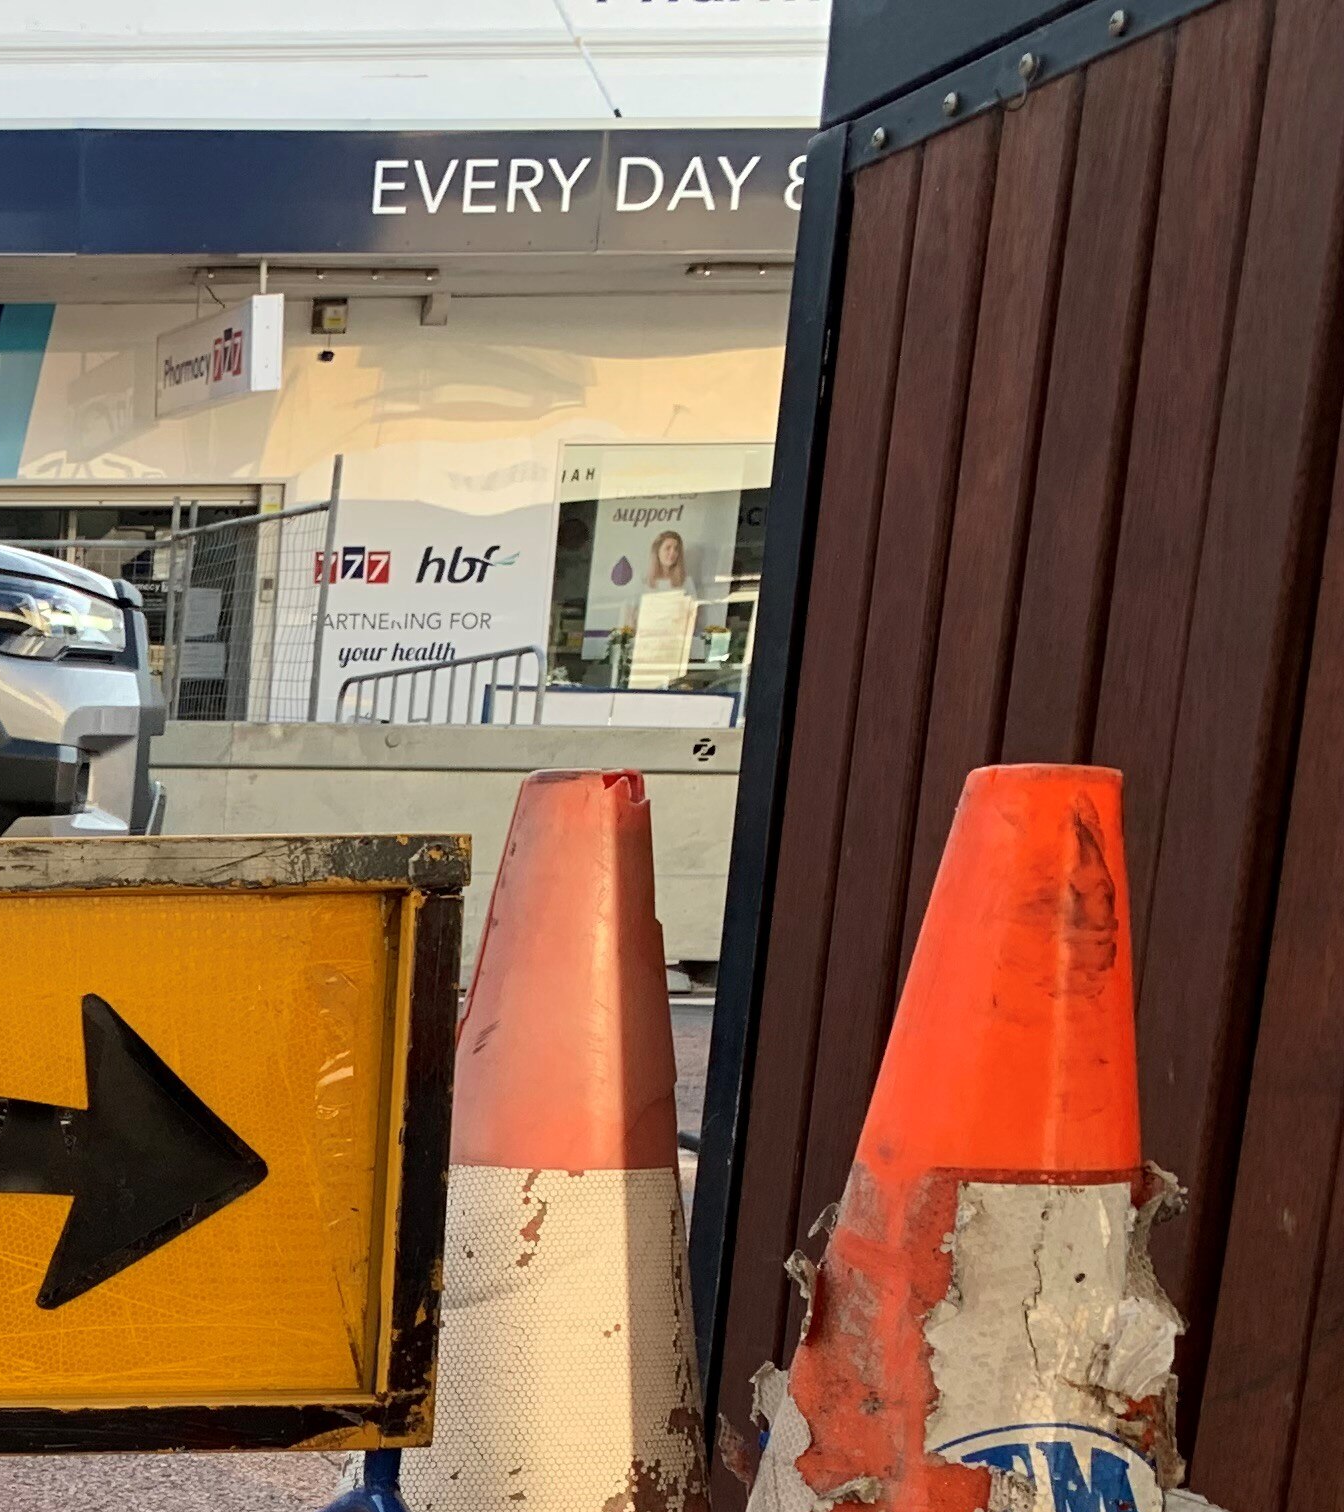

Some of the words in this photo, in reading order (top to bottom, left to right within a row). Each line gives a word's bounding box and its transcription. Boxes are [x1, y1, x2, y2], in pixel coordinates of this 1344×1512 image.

[372, 157, 592, 214] EVERY
[616, 155, 761, 212] DAY
[163, 352, 211, 389] Pharmacy
[612, 503, 684, 528] support
[415, 545, 501, 583] hbf
[449, 612, 492, 630] FOR
[338, 646, 387, 668] your
[390, 642, 455, 661] health
